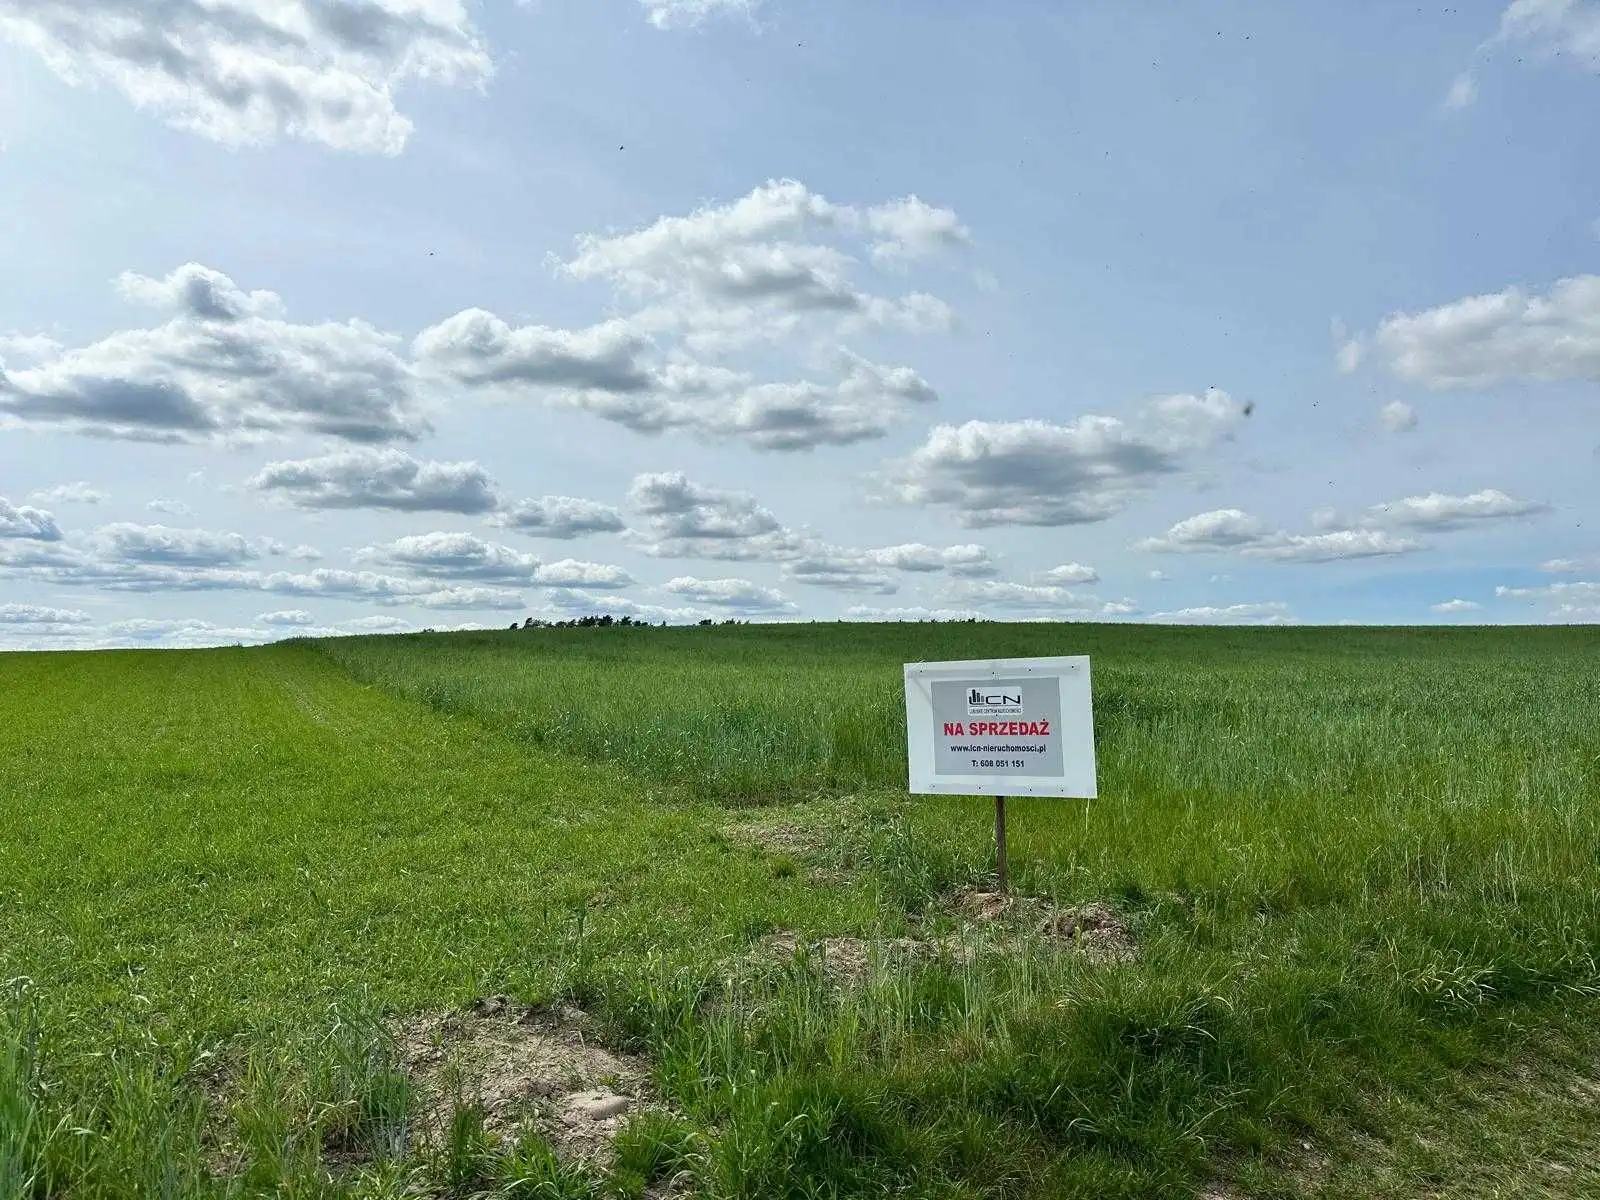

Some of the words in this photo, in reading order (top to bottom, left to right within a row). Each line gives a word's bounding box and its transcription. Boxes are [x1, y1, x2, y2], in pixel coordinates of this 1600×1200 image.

[944, 723, 965, 736] NA
[970, 719, 1050, 736] SPRZEDAŻ
[951, 744, 1046, 753] www.lcn-nieruchomosci.pl
[971, 760, 979, 768] T:
[996, 760, 1010, 768] 051
[1012, 760, 1025, 768] 151
